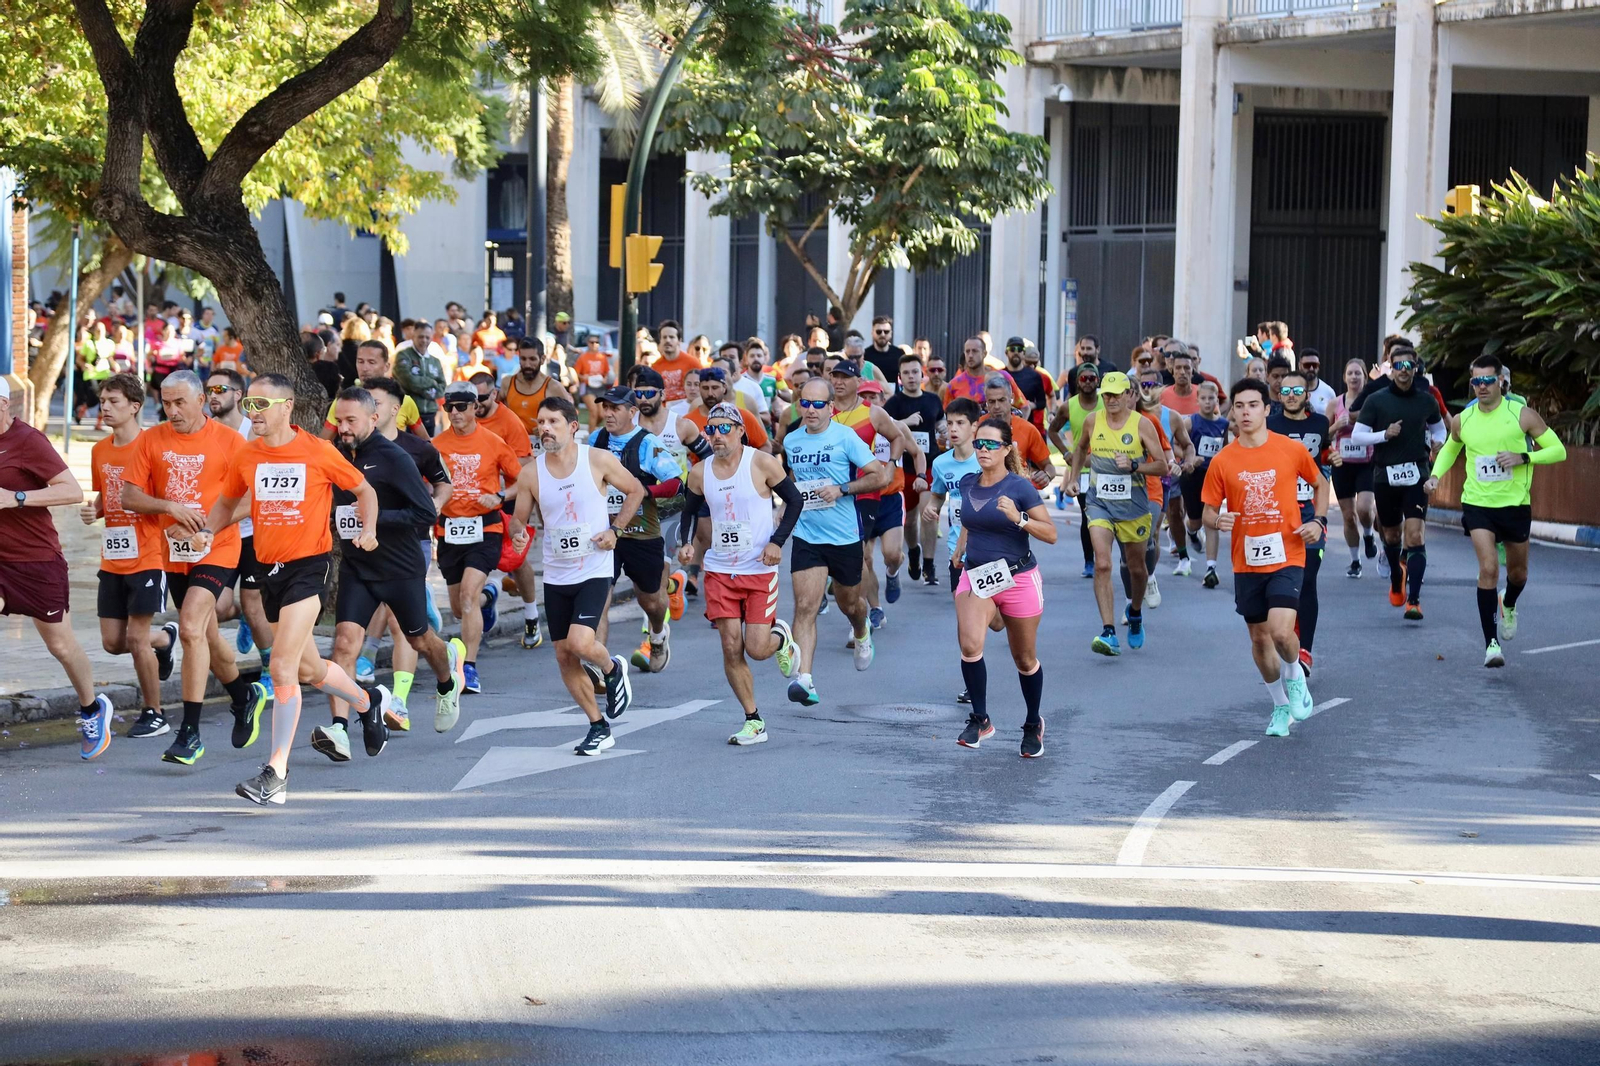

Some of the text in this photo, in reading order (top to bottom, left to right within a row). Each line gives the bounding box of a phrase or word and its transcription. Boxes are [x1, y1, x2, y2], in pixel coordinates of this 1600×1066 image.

[792, 450, 831, 466] nerja
[1393, 470, 1414, 481] 843
[261, 477, 299, 488] 1737
[1101, 483, 1126, 493] 439
[340, 517, 363, 529] 606
[450, 525, 475, 536] 672
[106, 537, 130, 550] 853
[560, 537, 580, 549] 36
[721, 532, 739, 544] 35
[173, 541, 197, 553] 34
[1252, 546, 1272, 558] 72
[976, 571, 1004, 590] 242
